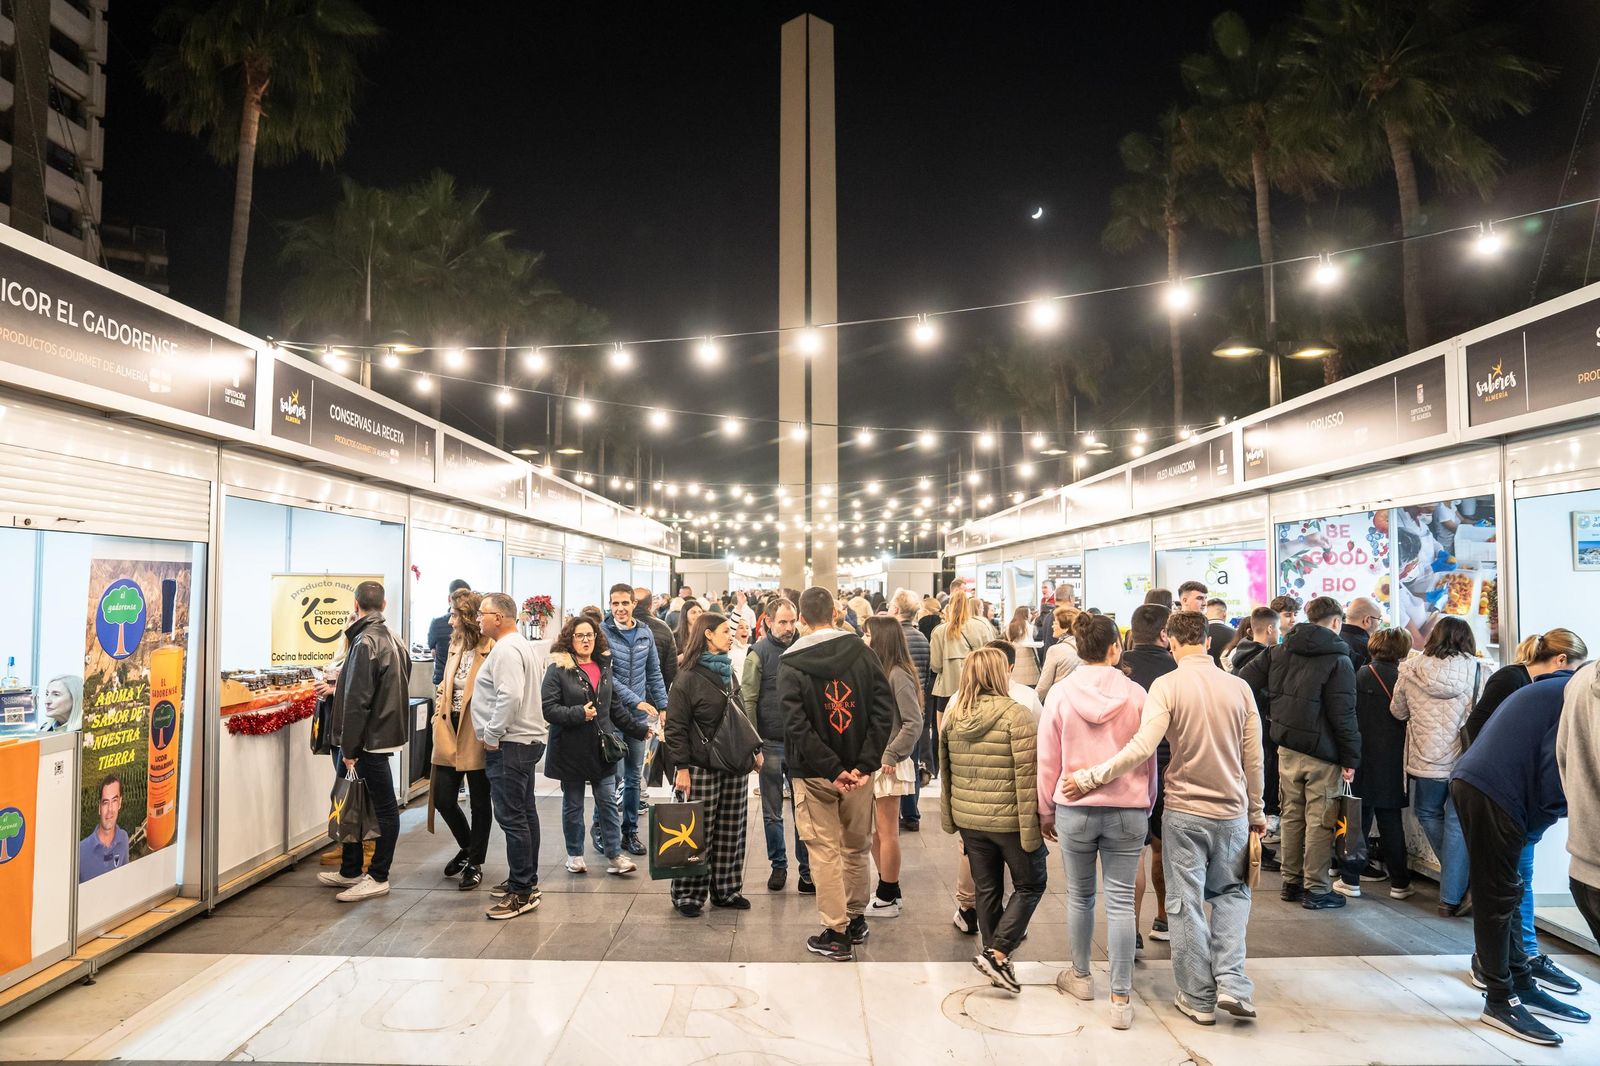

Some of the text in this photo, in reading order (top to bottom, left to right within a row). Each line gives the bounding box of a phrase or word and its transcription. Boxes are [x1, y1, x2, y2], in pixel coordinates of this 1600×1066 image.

[1, 278, 51, 318] ICOR
[57, 299, 79, 328] EL
[59, 346, 102, 369] GOURMET
[103, 360, 116, 373] DE
[329, 404, 405, 445] CONSERVAS LA RECETA
[1326, 524, 1350, 538] BE
[1310, 551, 1368, 565] GOOD
[290, 580, 333, 599] producto
[1322, 578, 1356, 592] BIO
[272, 651, 335, 661] Cocina tradicional
[94, 682, 146, 707] AROMA Y
[91, 709, 130, 729] SABOR
[130, 706, 144, 722] DE
[92, 727, 141, 750] NUESTRA
[98, 748, 136, 770] TIERRA
